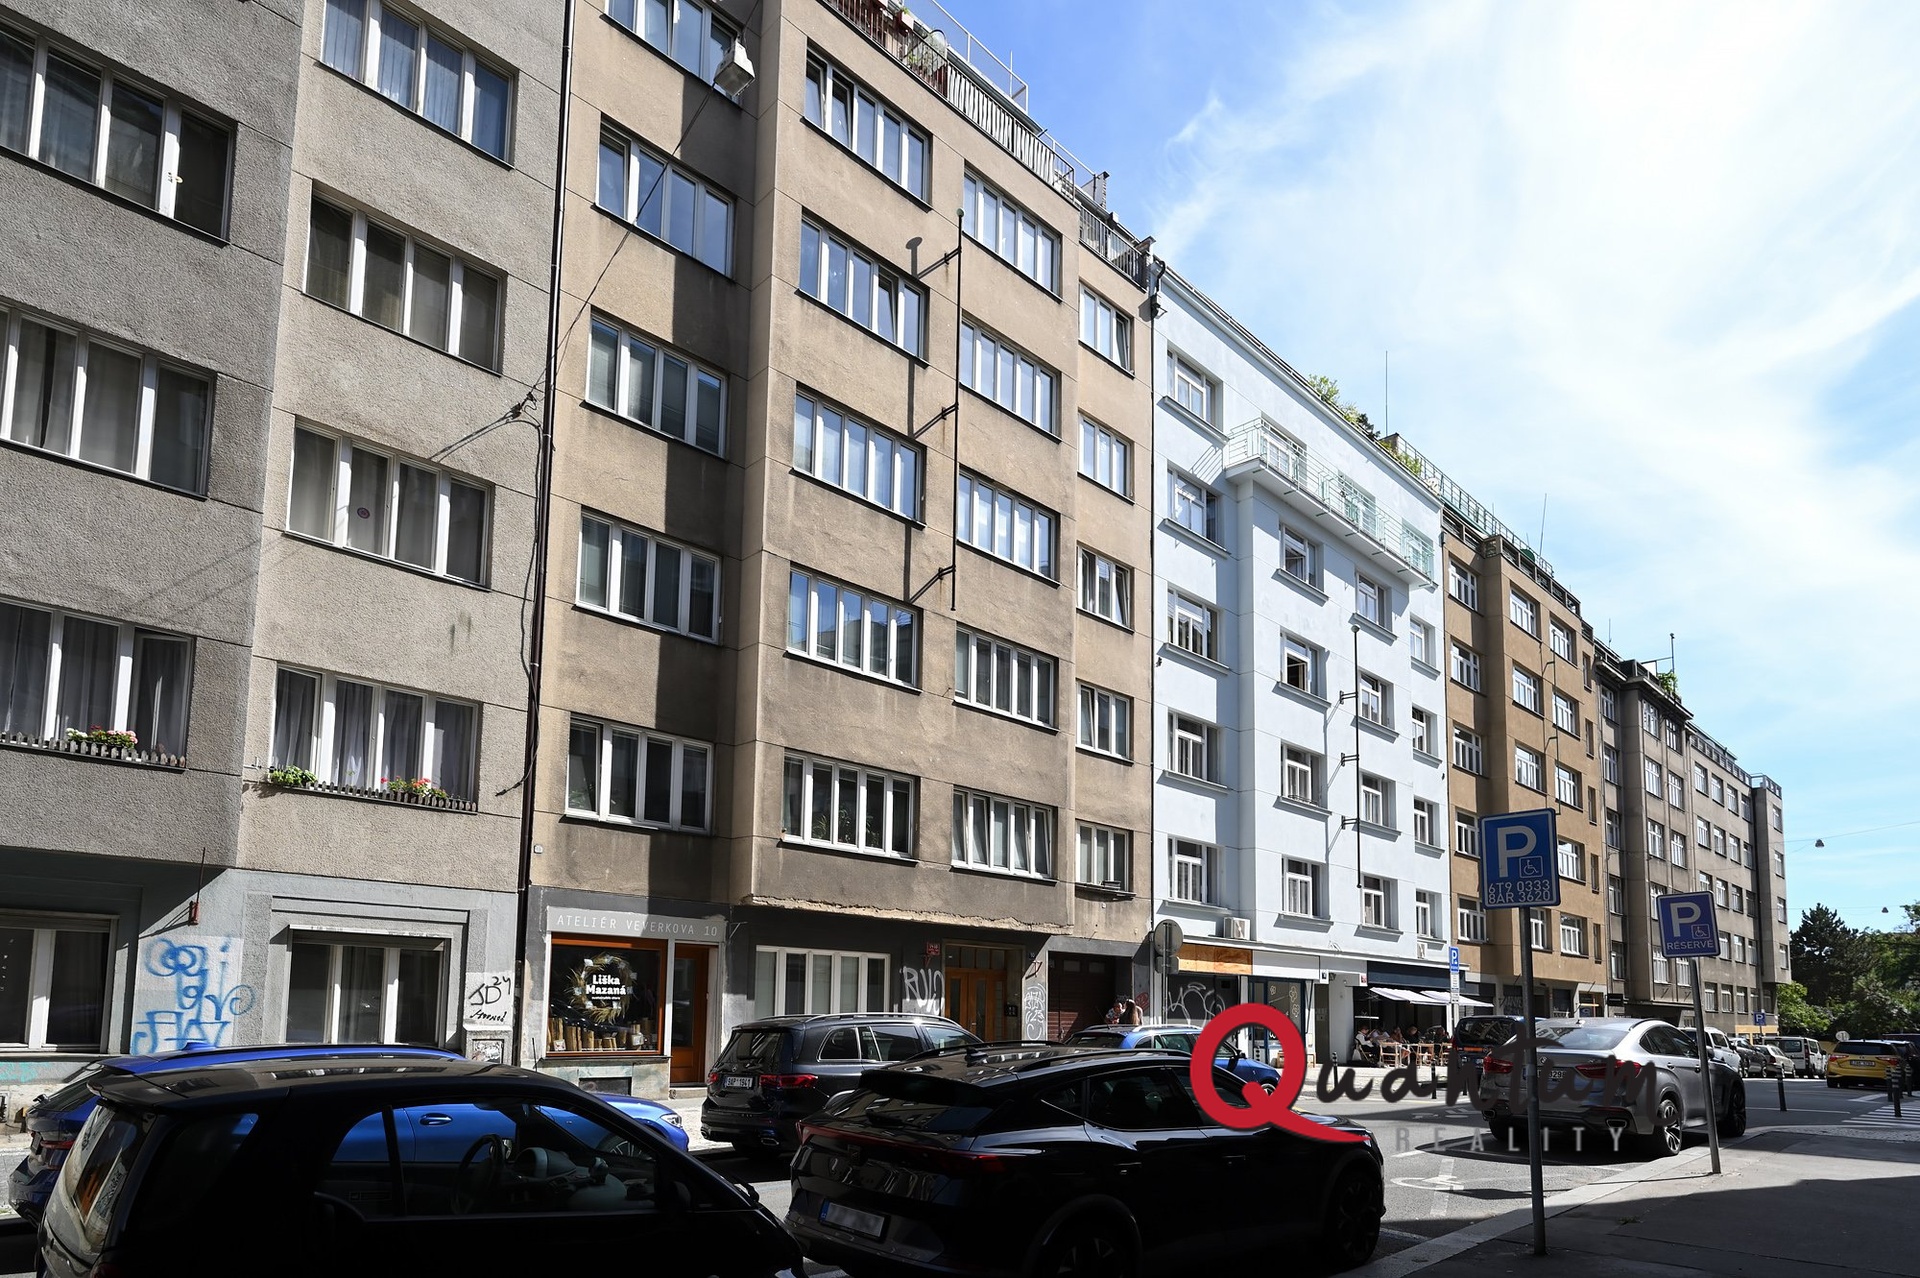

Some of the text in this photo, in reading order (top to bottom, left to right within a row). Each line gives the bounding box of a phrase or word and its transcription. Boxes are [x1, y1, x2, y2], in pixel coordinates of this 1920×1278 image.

[1497, 825, 1537, 878] P
[1488, 879, 1550, 895] 6T9 0333
[1488, 890, 1551, 904] 8AR 3620
[557, 914, 718, 937] ATELIÉR VEVERKOVA 10
[1670, 901, 1701, 938] P
[592, 974, 621, 985] Liška
[586, 984, 626, 995] Mazaná
[1755, 1014, 1763, 1023] P
